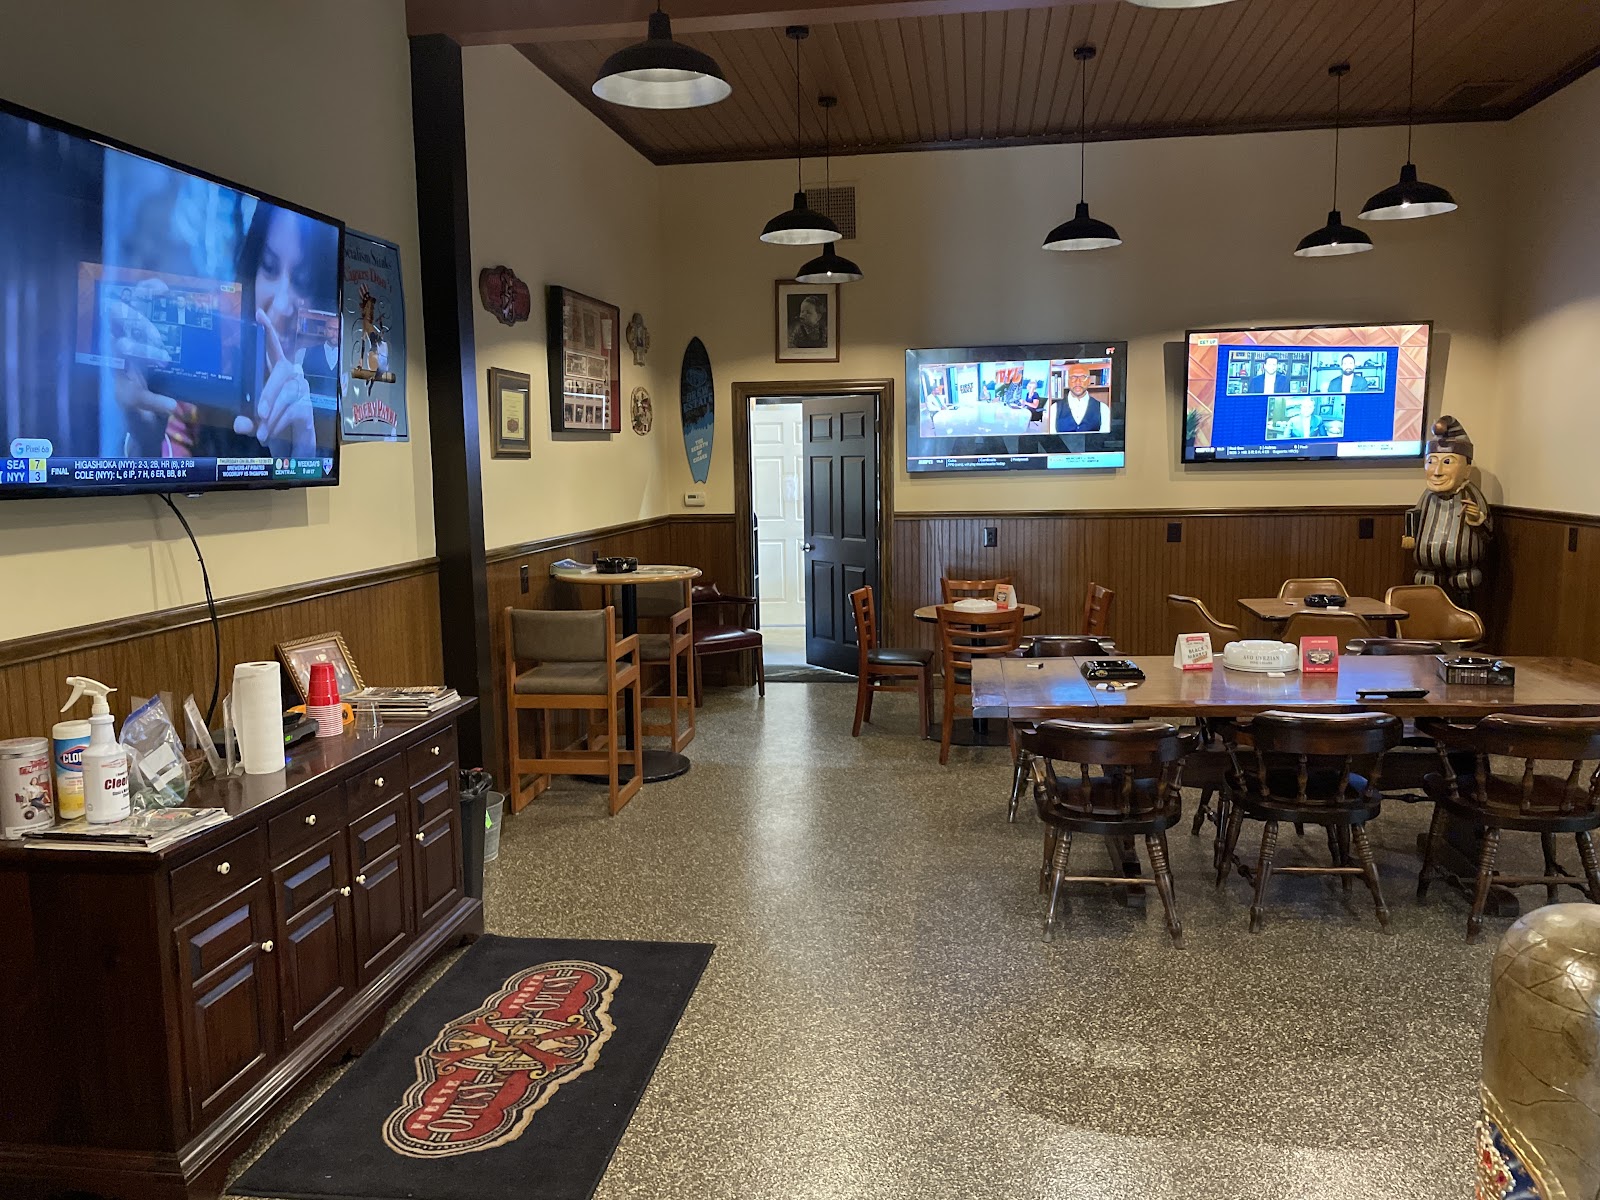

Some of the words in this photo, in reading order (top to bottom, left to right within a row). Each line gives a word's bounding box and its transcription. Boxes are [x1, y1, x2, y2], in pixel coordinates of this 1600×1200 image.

[344, 248, 370, 264] ocialism
[26, 445, 40, 453] Pixel
[7, 460, 25, 470] SEA
[35, 460, 41, 470] 7
[75, 460, 117, 470] HIGASHIOKA
[118, 460, 137, 470] (NYY):
[138, 460, 149, 470] 2-3,
[150, 460, 160, 470] 2B,
[161, 460, 170, 470] HR
[181, 460, 185, 470] 2
[185, 460, 195, 470] RBI
[7, 472, 25, 482] NYY
[35, 471, 41, 482] 3
[51, 467, 70, 476] FINAL
[75, 470, 94, 480] COLE
[95, 470, 115, 480] (NYY):
[117, 470, 122, 480] L,
[123, 470, 128, 480] 6
[128, 470, 137, 480] IP,
[138, 470, 142, 480] 7
[143, 470, 150, 480] H,
[151, 470, 155, 480] 6
[156, 470, 166, 480] ER,
[167, 470, 177, 480] BB,
[182, 470, 187, 480] K
[1188, 646, 1204, 654] BLACK
